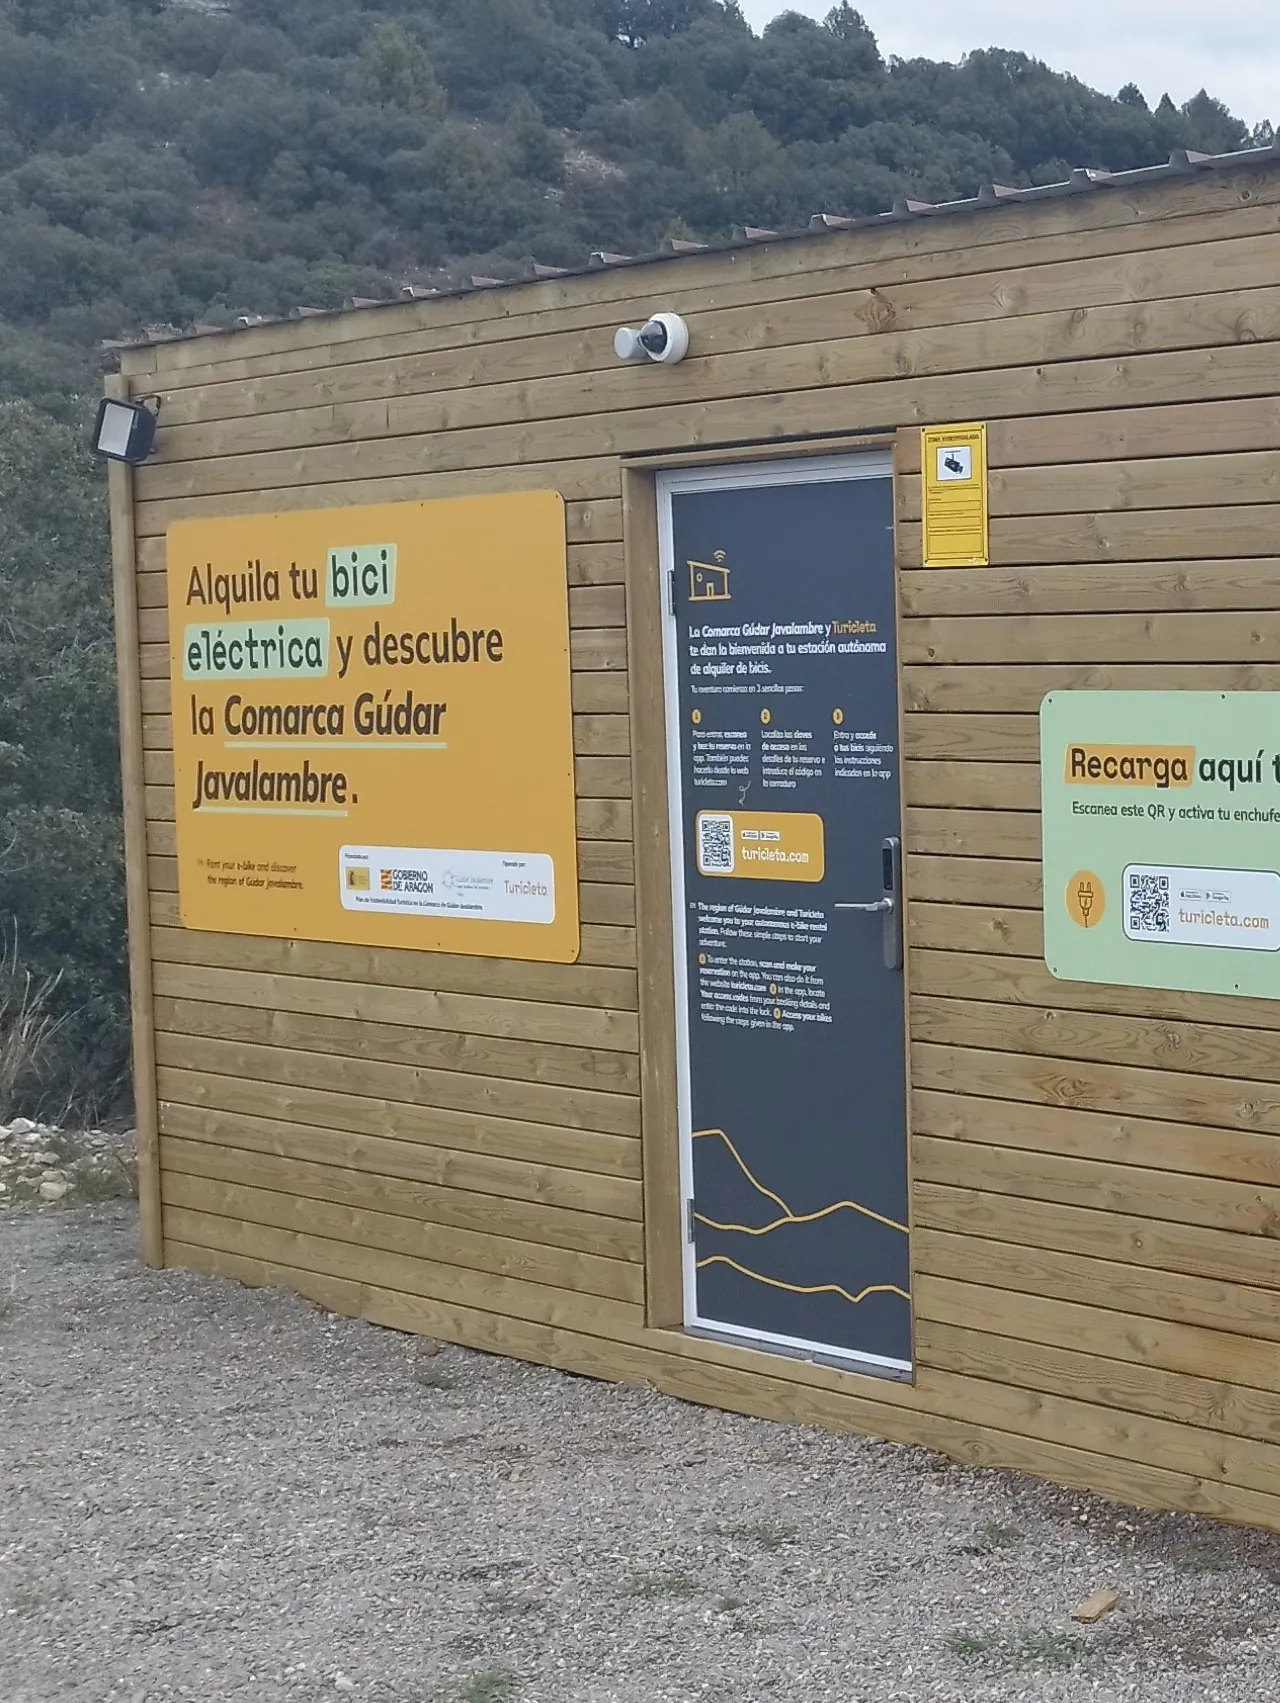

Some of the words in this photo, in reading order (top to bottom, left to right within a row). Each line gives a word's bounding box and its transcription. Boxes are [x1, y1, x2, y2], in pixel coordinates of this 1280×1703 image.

[186, 560, 280, 615] Alquila
[289, 562, 318, 599] tu
[331, 549, 389, 598] bici
[689, 626, 700, 638] La
[702, 625, 740, 637] Comarca
[743, 621, 770, 636] Gúdar
[771, 621, 823, 639] Javalambre
[825, 624, 831, 637] y
[832, 620, 876, 633] Turicleta
[187, 625, 322, 672] eléctrica
[336, 635, 353, 678] y
[363, 617, 504, 666] descubre
[689, 645, 699, 656] te
[700, 642, 717, 655] dan
[718, 642, 727, 655] la
[728, 642, 775, 655] bienvenida
[778, 645, 784, 654] a
[786, 643, 796, 654] tu
[798, 639, 836, 653] estación
[838, 639, 887, 653] autónoma
[690, 663, 701, 674] de
[703, 661, 735, 679] alquiler
[736, 661, 747, 674] de
[191, 695, 214, 736] la
[224, 695, 344, 736] Comarca
[354, 690, 447, 735] Gúdar
[1071, 748, 1188, 788] Recarga
[1199, 749, 1264, 792] aquí
[192, 759, 358, 810] Javalambre.
[1072, 801, 1117, 816] Escanea
[1121, 804, 1144, 817] este
[1148, 803, 1165, 820] QR
[1168, 808, 1176, 822] y
[1179, 804, 1214, 820] activa
[1218, 807, 1230, 820] tu
[1234, 806, 1280, 823] enchufe
[742, 846, 809, 863] turicleta.com
[392, 869, 428, 881] GOBIERNO
[393, 881, 402, 891] DE
[504, 880, 547, 896] Turicleta
[1178, 908, 1269, 930] turicleta.com
